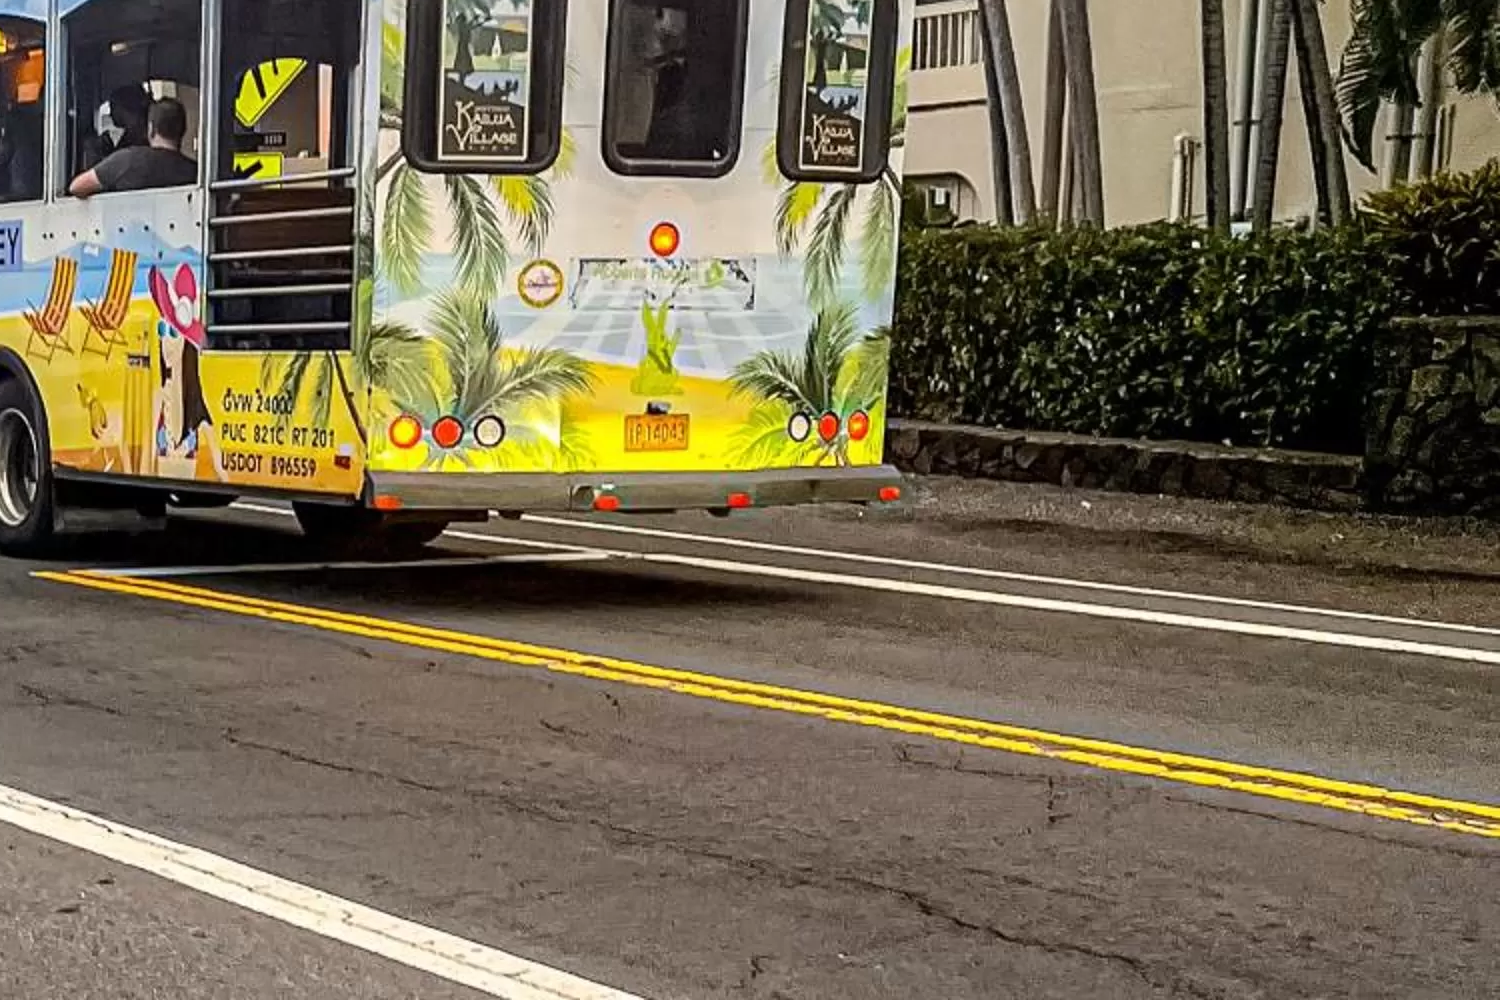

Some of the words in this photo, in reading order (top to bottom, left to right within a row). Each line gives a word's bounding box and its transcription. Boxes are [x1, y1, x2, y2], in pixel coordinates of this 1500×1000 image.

[445, 123, 518, 151] VILLAGE
[223, 392, 253, 412] GVW
[221, 423, 247, 443] PUC
[253, 424, 285, 446] 821C
[291, 427, 309, 447] RT
[311, 428, 335, 448] 201
[220, 452, 263, 474] USDOT
